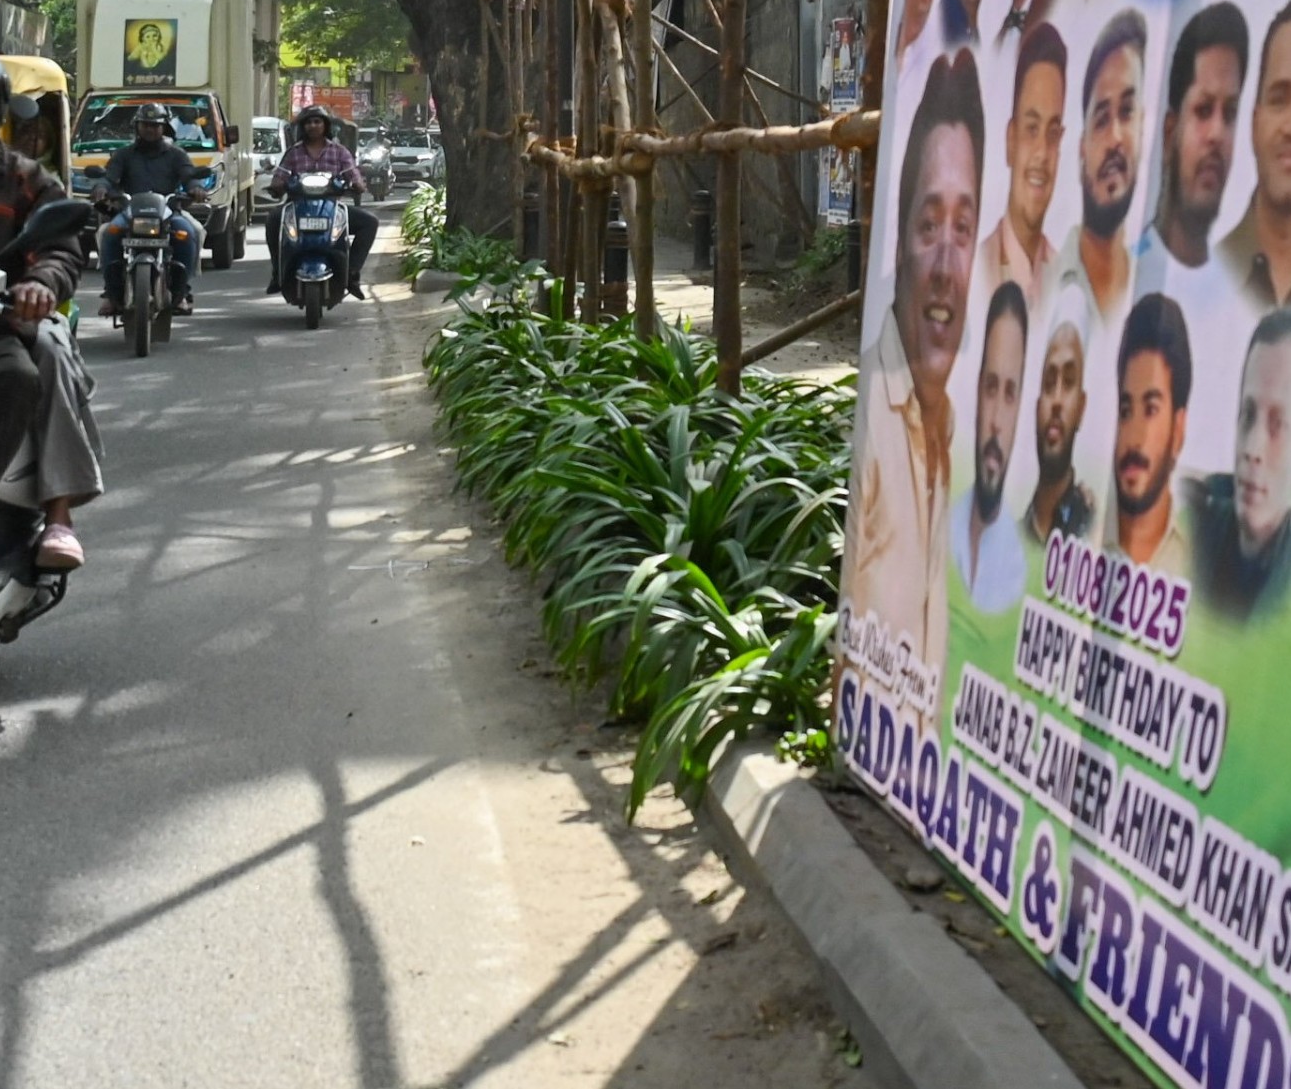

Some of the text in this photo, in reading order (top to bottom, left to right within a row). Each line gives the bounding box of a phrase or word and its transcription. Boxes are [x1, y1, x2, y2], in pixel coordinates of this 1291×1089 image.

[1017, 606, 1219, 775] HAPPY BIRTHDAY TO
[1046, 536, 1186, 649] 01/08/2025
[838, 676, 1021, 901] SADAQATH
[1023, 832, 1058, 940] &
[953, 671, 1006, 755] JANAB
[1035, 726, 1113, 838] ZAMEER
[1110, 780, 1197, 891] AHMED
[1192, 832, 1275, 951] KHAN
